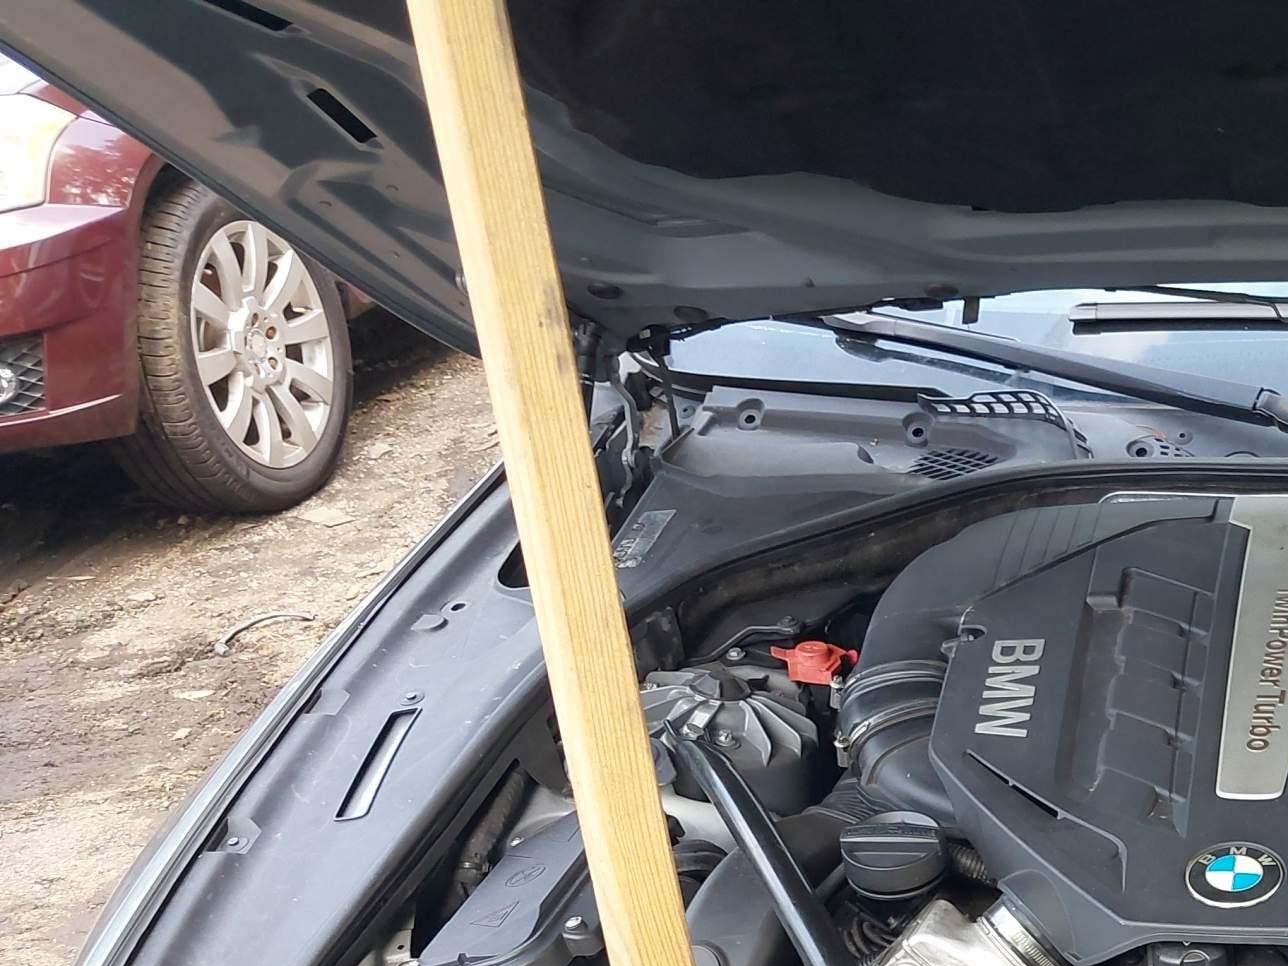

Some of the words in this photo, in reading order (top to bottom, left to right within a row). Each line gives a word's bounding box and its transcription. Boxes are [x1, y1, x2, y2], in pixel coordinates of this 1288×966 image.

[974, 638, 1046, 738] BMW
[1246, 690, 1287, 753] Turbo
[1198, 846, 1277, 866] BMW
